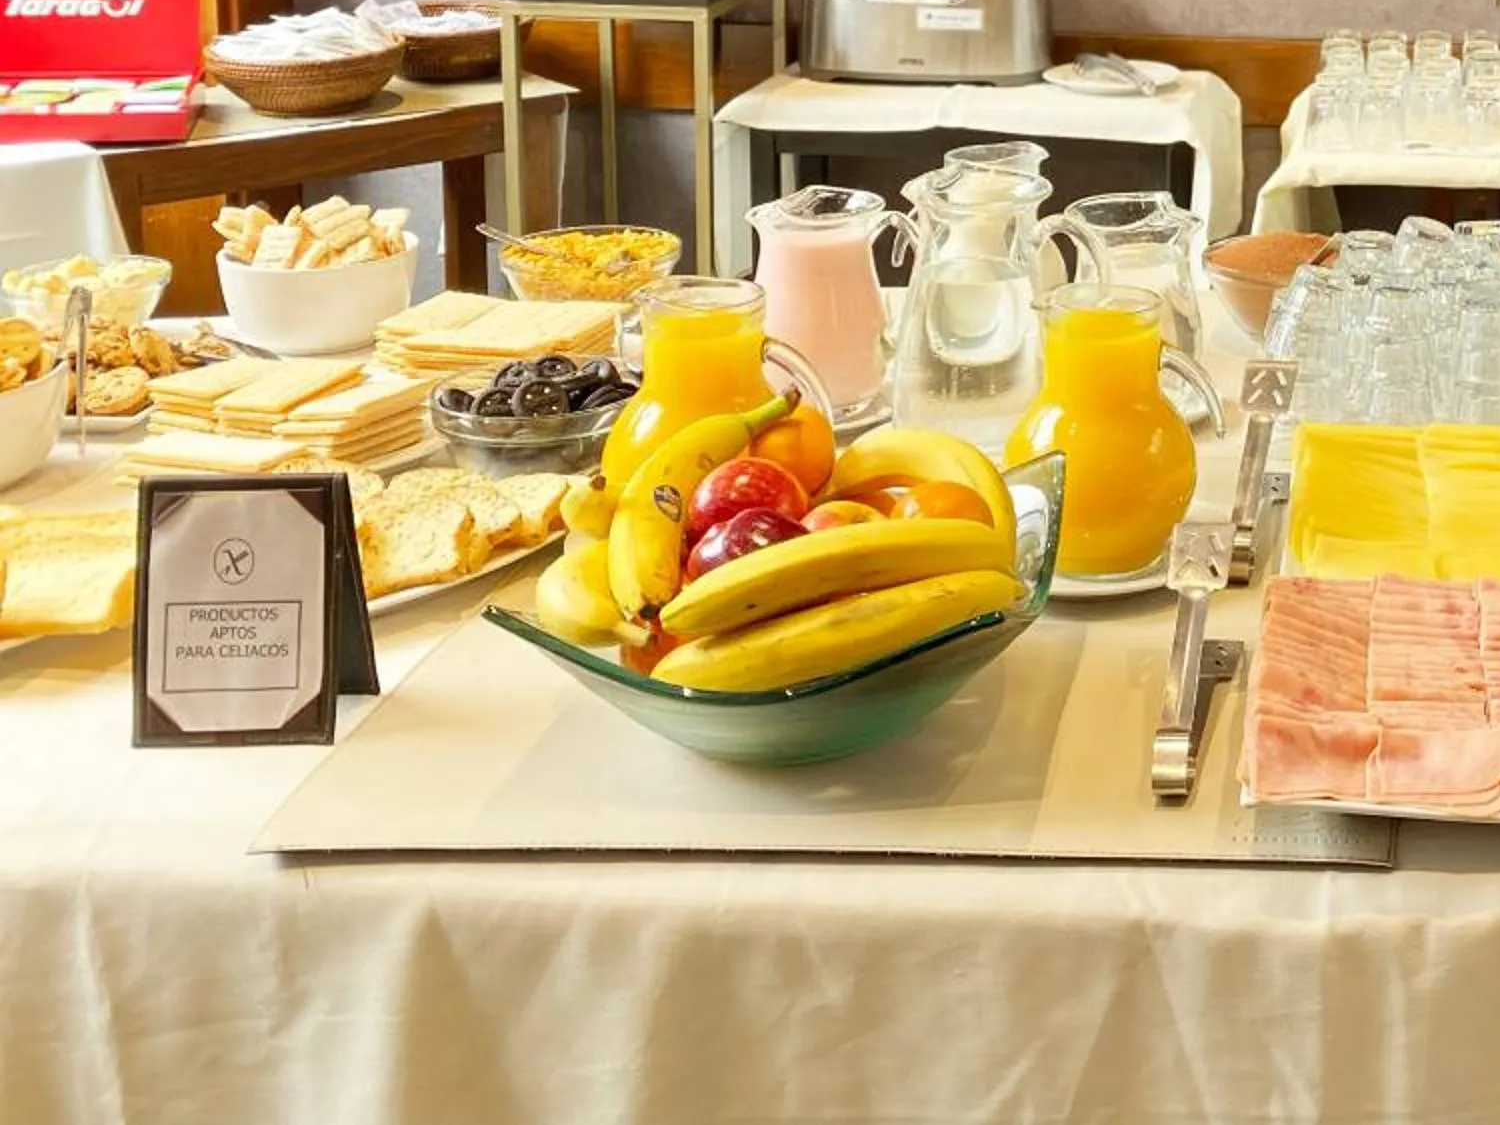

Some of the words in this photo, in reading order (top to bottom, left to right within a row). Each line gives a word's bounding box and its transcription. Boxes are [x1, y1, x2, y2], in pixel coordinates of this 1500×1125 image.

[189, 607, 279, 622] PRODUCTOS
[209, 626, 257, 640] APTOS
[175, 646, 215, 659] PARA
[219, 644, 289, 658] CELIACOS
